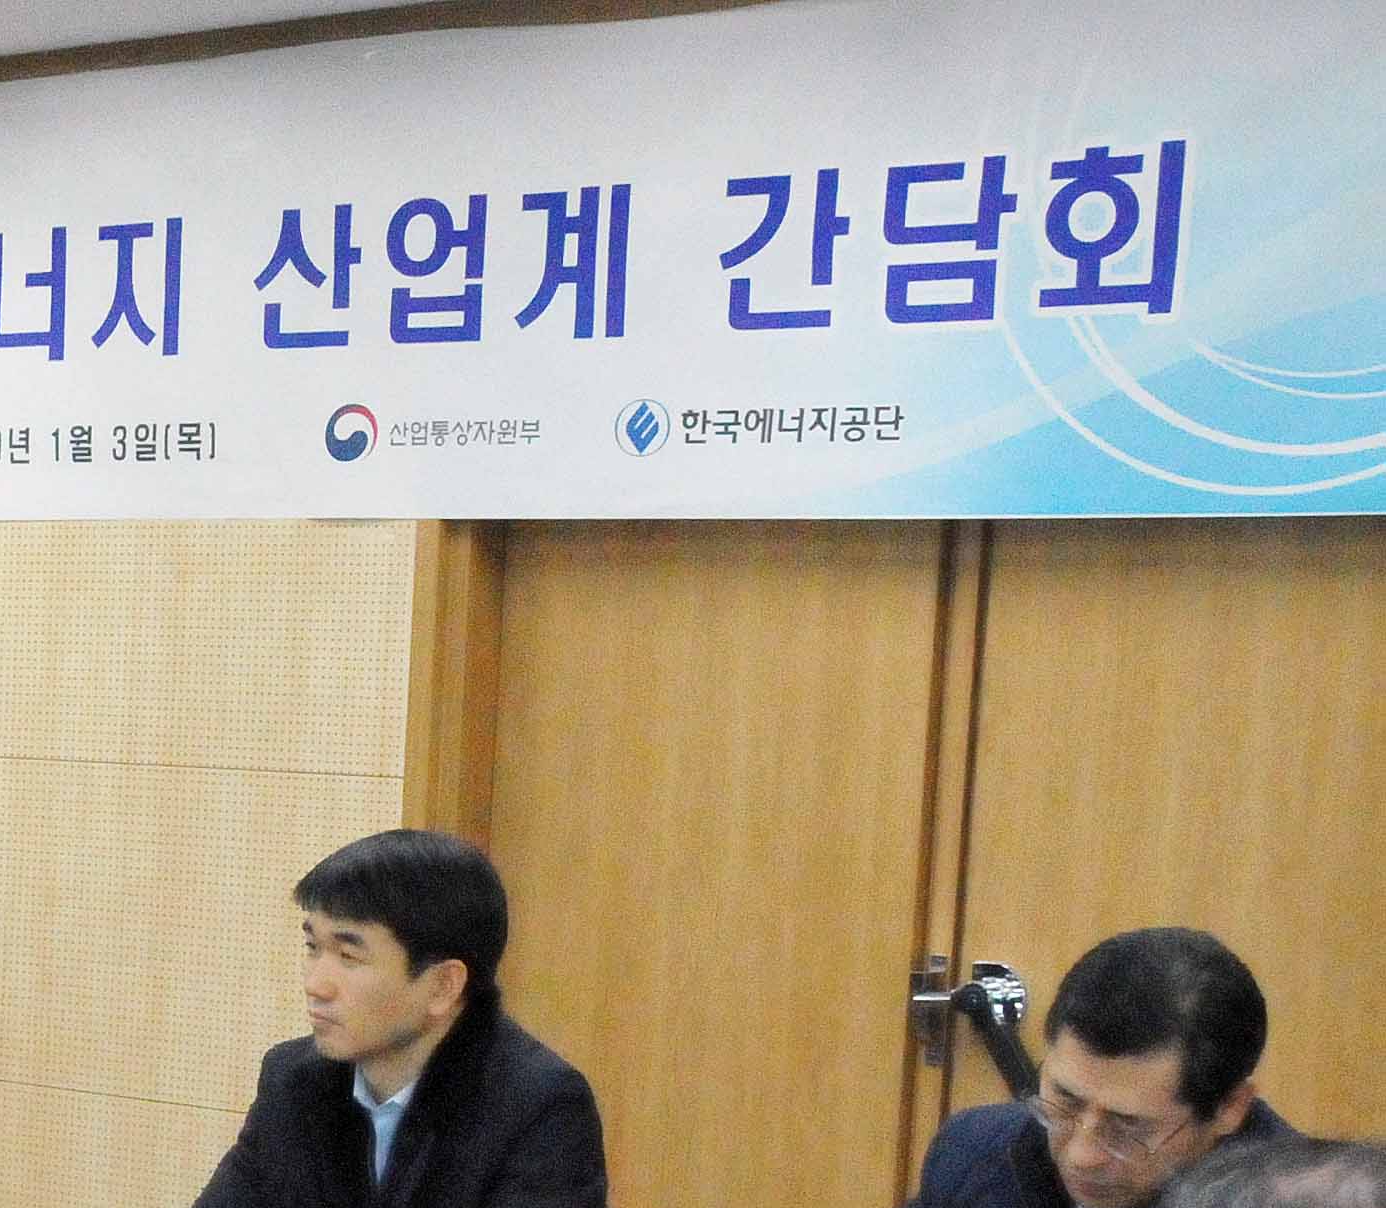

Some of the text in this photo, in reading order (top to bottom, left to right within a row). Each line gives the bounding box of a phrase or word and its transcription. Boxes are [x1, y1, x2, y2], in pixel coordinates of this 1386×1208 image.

[254, 183, 630, 349] 산업계
[720, 139, 1186, 330] 간담회
[390, 419, 541, 447] 산업통상자원부
[681, 405, 905, 444] 한국에너지공단
[51, 425, 93, 463] 1월
